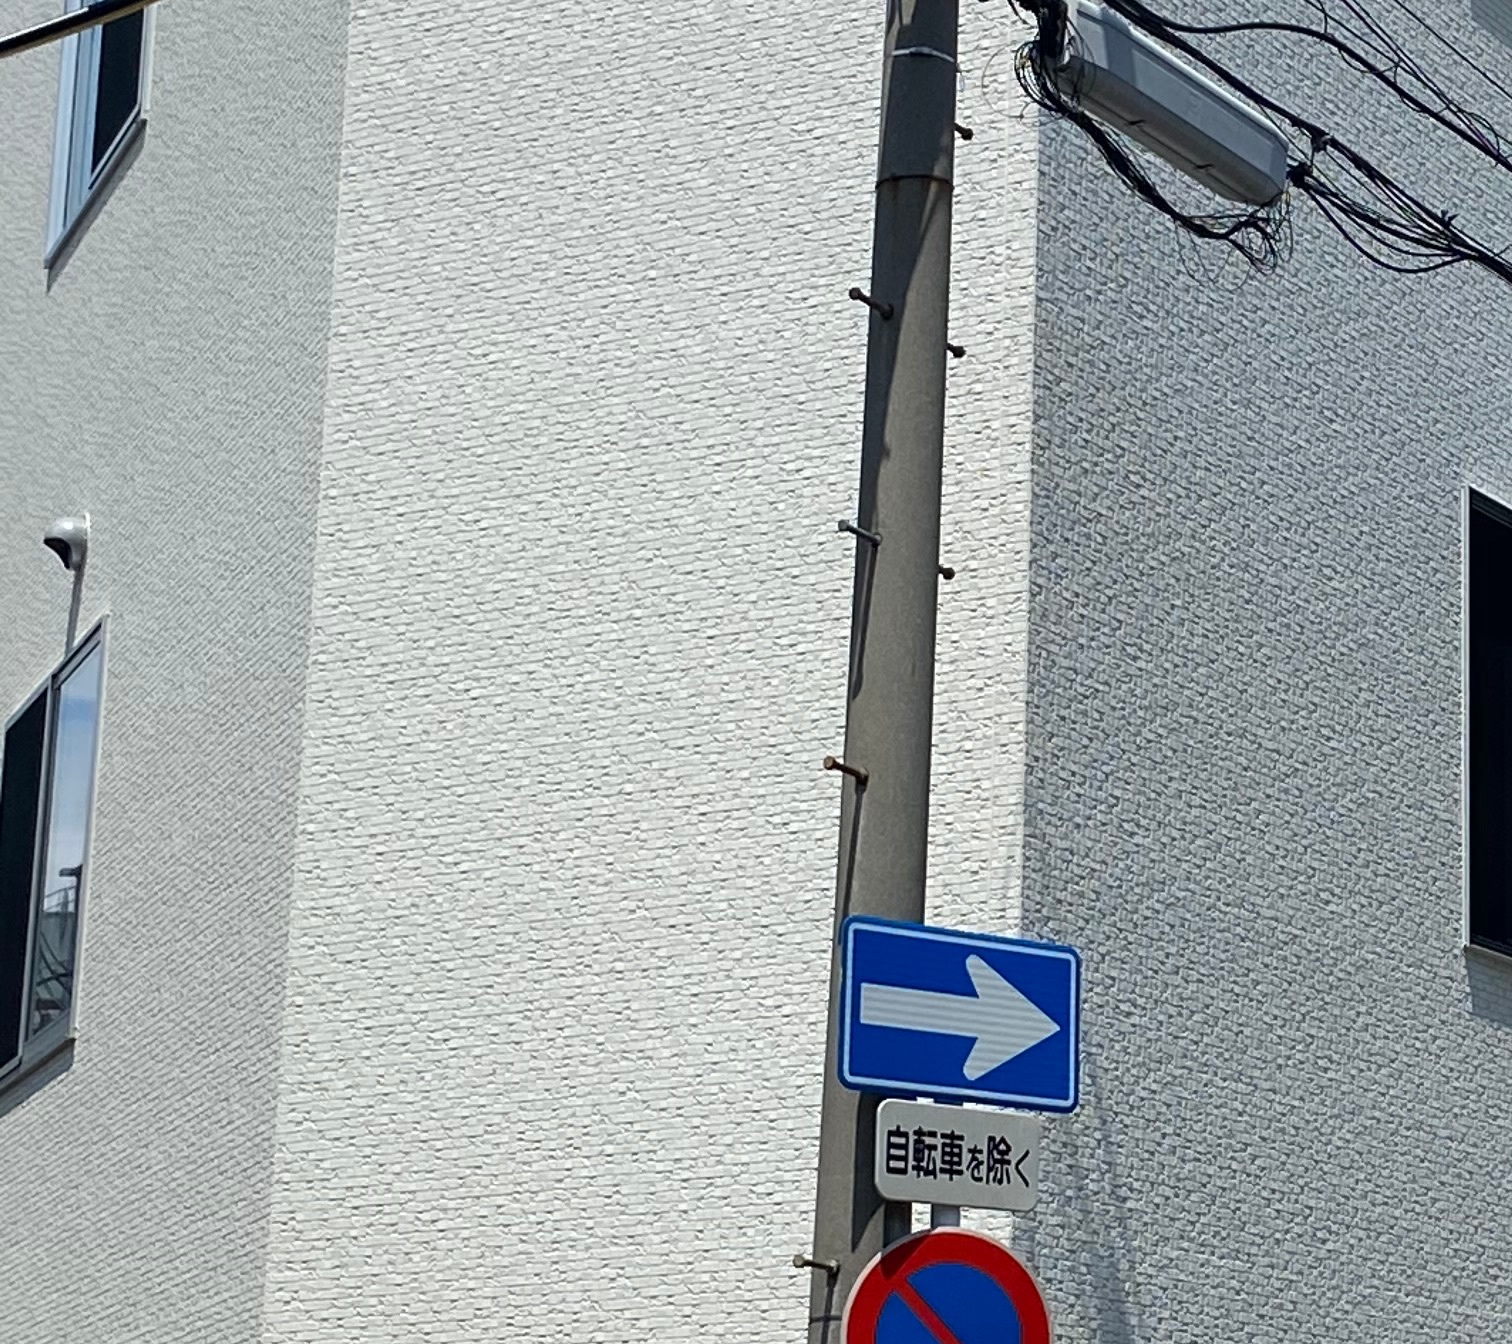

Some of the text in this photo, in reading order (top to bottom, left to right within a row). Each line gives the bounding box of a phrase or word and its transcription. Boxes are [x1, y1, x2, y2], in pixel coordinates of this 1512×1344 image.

[886, 1124, 1030, 1188] 自転車を除く
